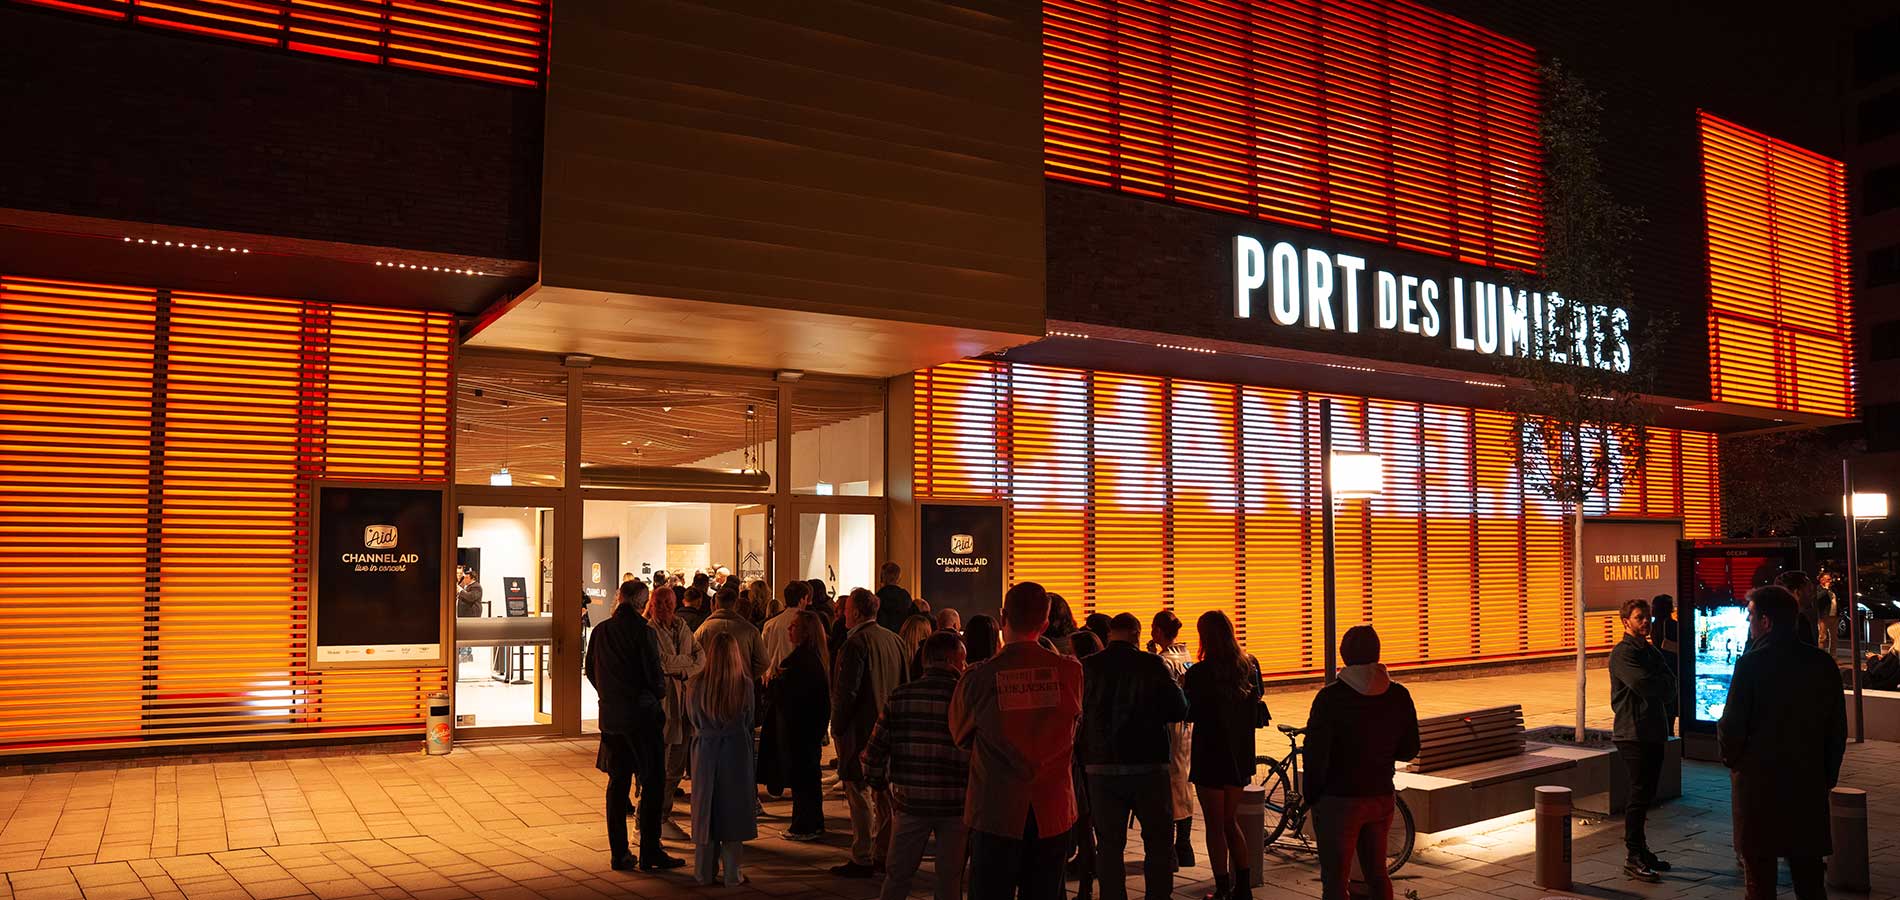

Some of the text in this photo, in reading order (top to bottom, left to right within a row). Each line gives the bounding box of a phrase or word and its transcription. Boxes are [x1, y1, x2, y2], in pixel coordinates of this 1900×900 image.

[1233, 235, 1366, 334] PORT
[1373, 269, 1440, 338] DES
[953, 364, 1496, 520] CHANNEL
[366, 528, 397, 547] Aid
[342, 553, 419, 563] CHANNEL AID
[936, 557, 988, 566] CHANNEL AID
[1595, 553, 1667, 564] WELCOME TO THE WORLD OF
[378, 563, 407, 572] concert
[1604, 564, 1660, 581] CHANNEL AID
